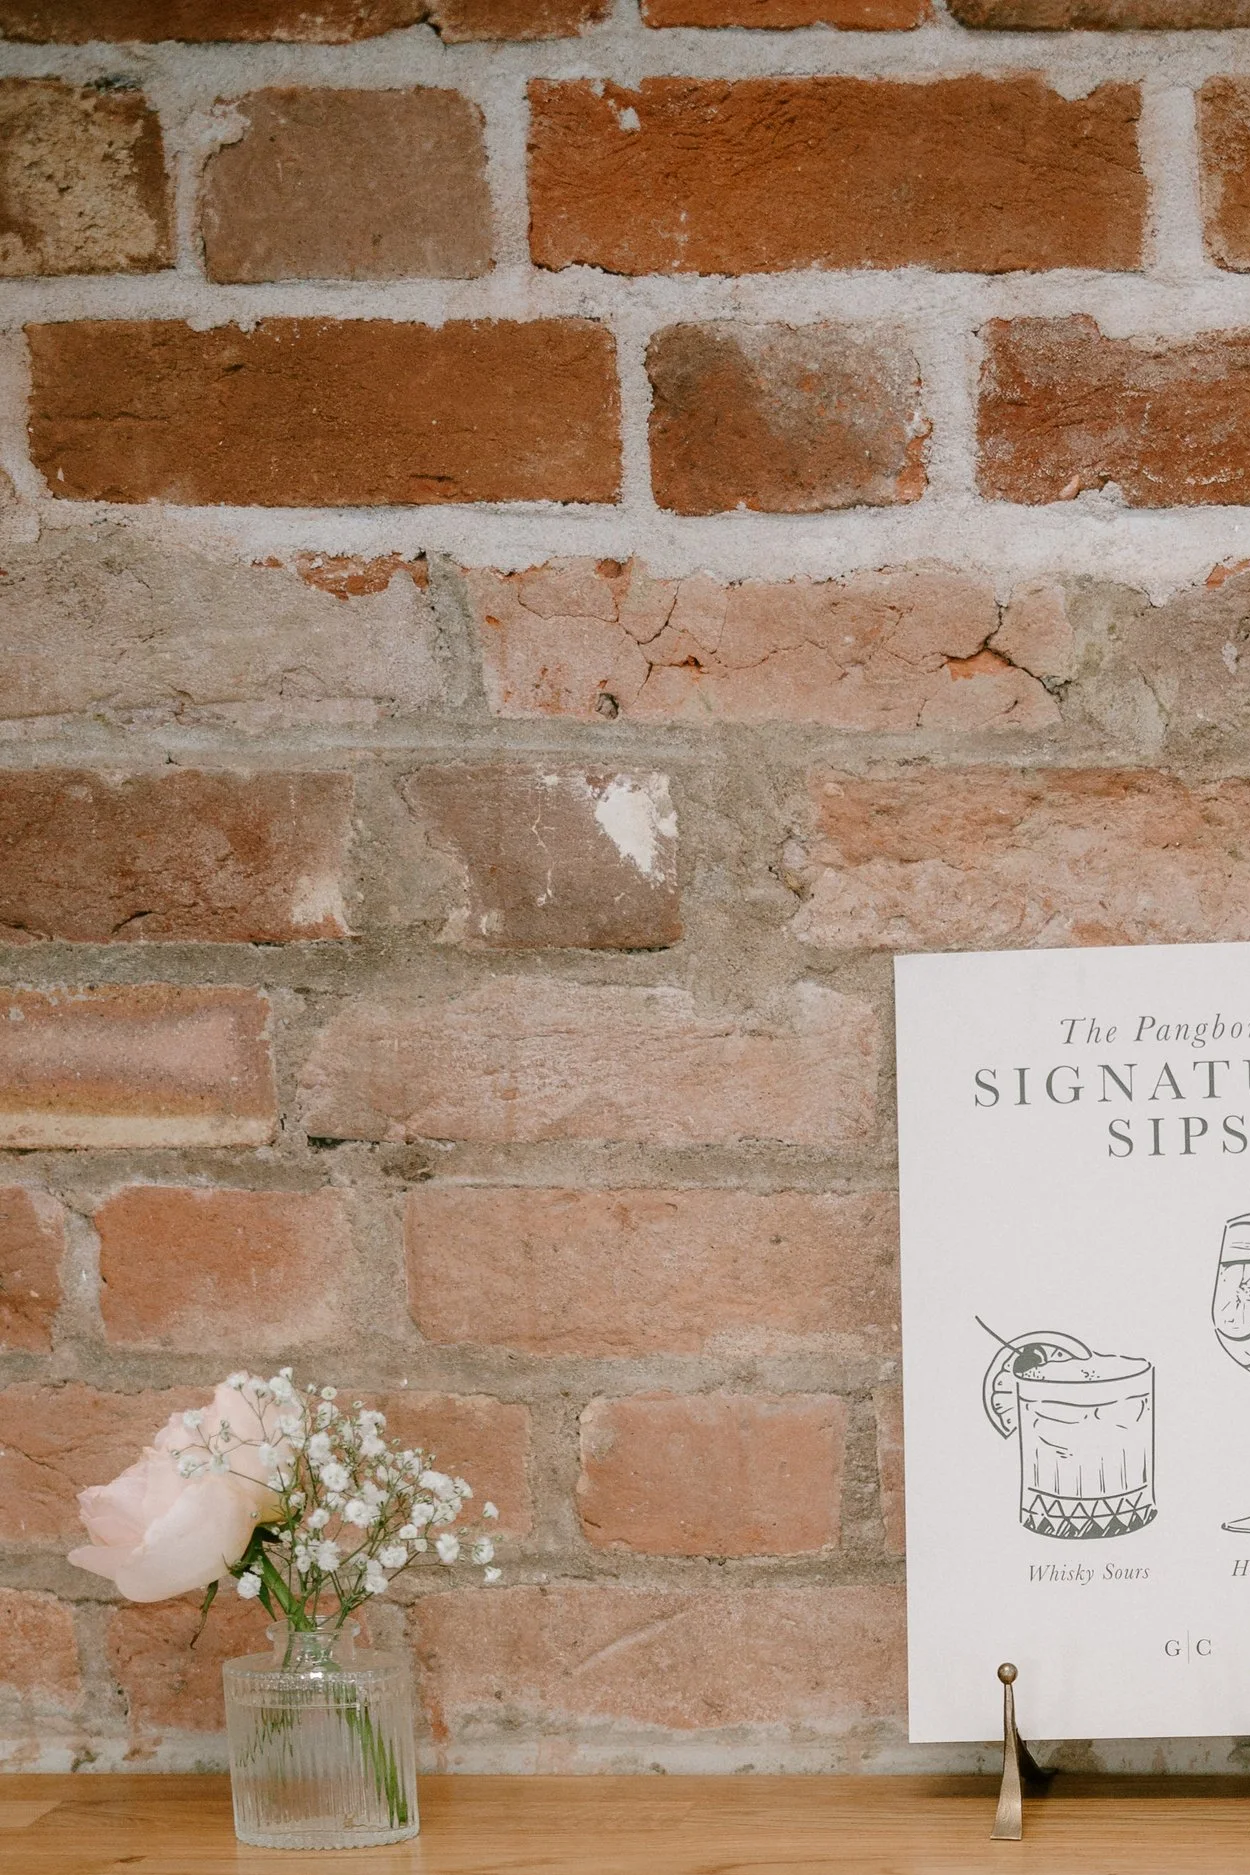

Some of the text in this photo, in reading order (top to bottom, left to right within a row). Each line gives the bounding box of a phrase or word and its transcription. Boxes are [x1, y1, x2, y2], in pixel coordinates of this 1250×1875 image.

[1060, 1016, 1118, 1045] The
[1107, 1114, 1249, 1159] SIPS
[1028, 1562, 1151, 1586] Whisky Sours
